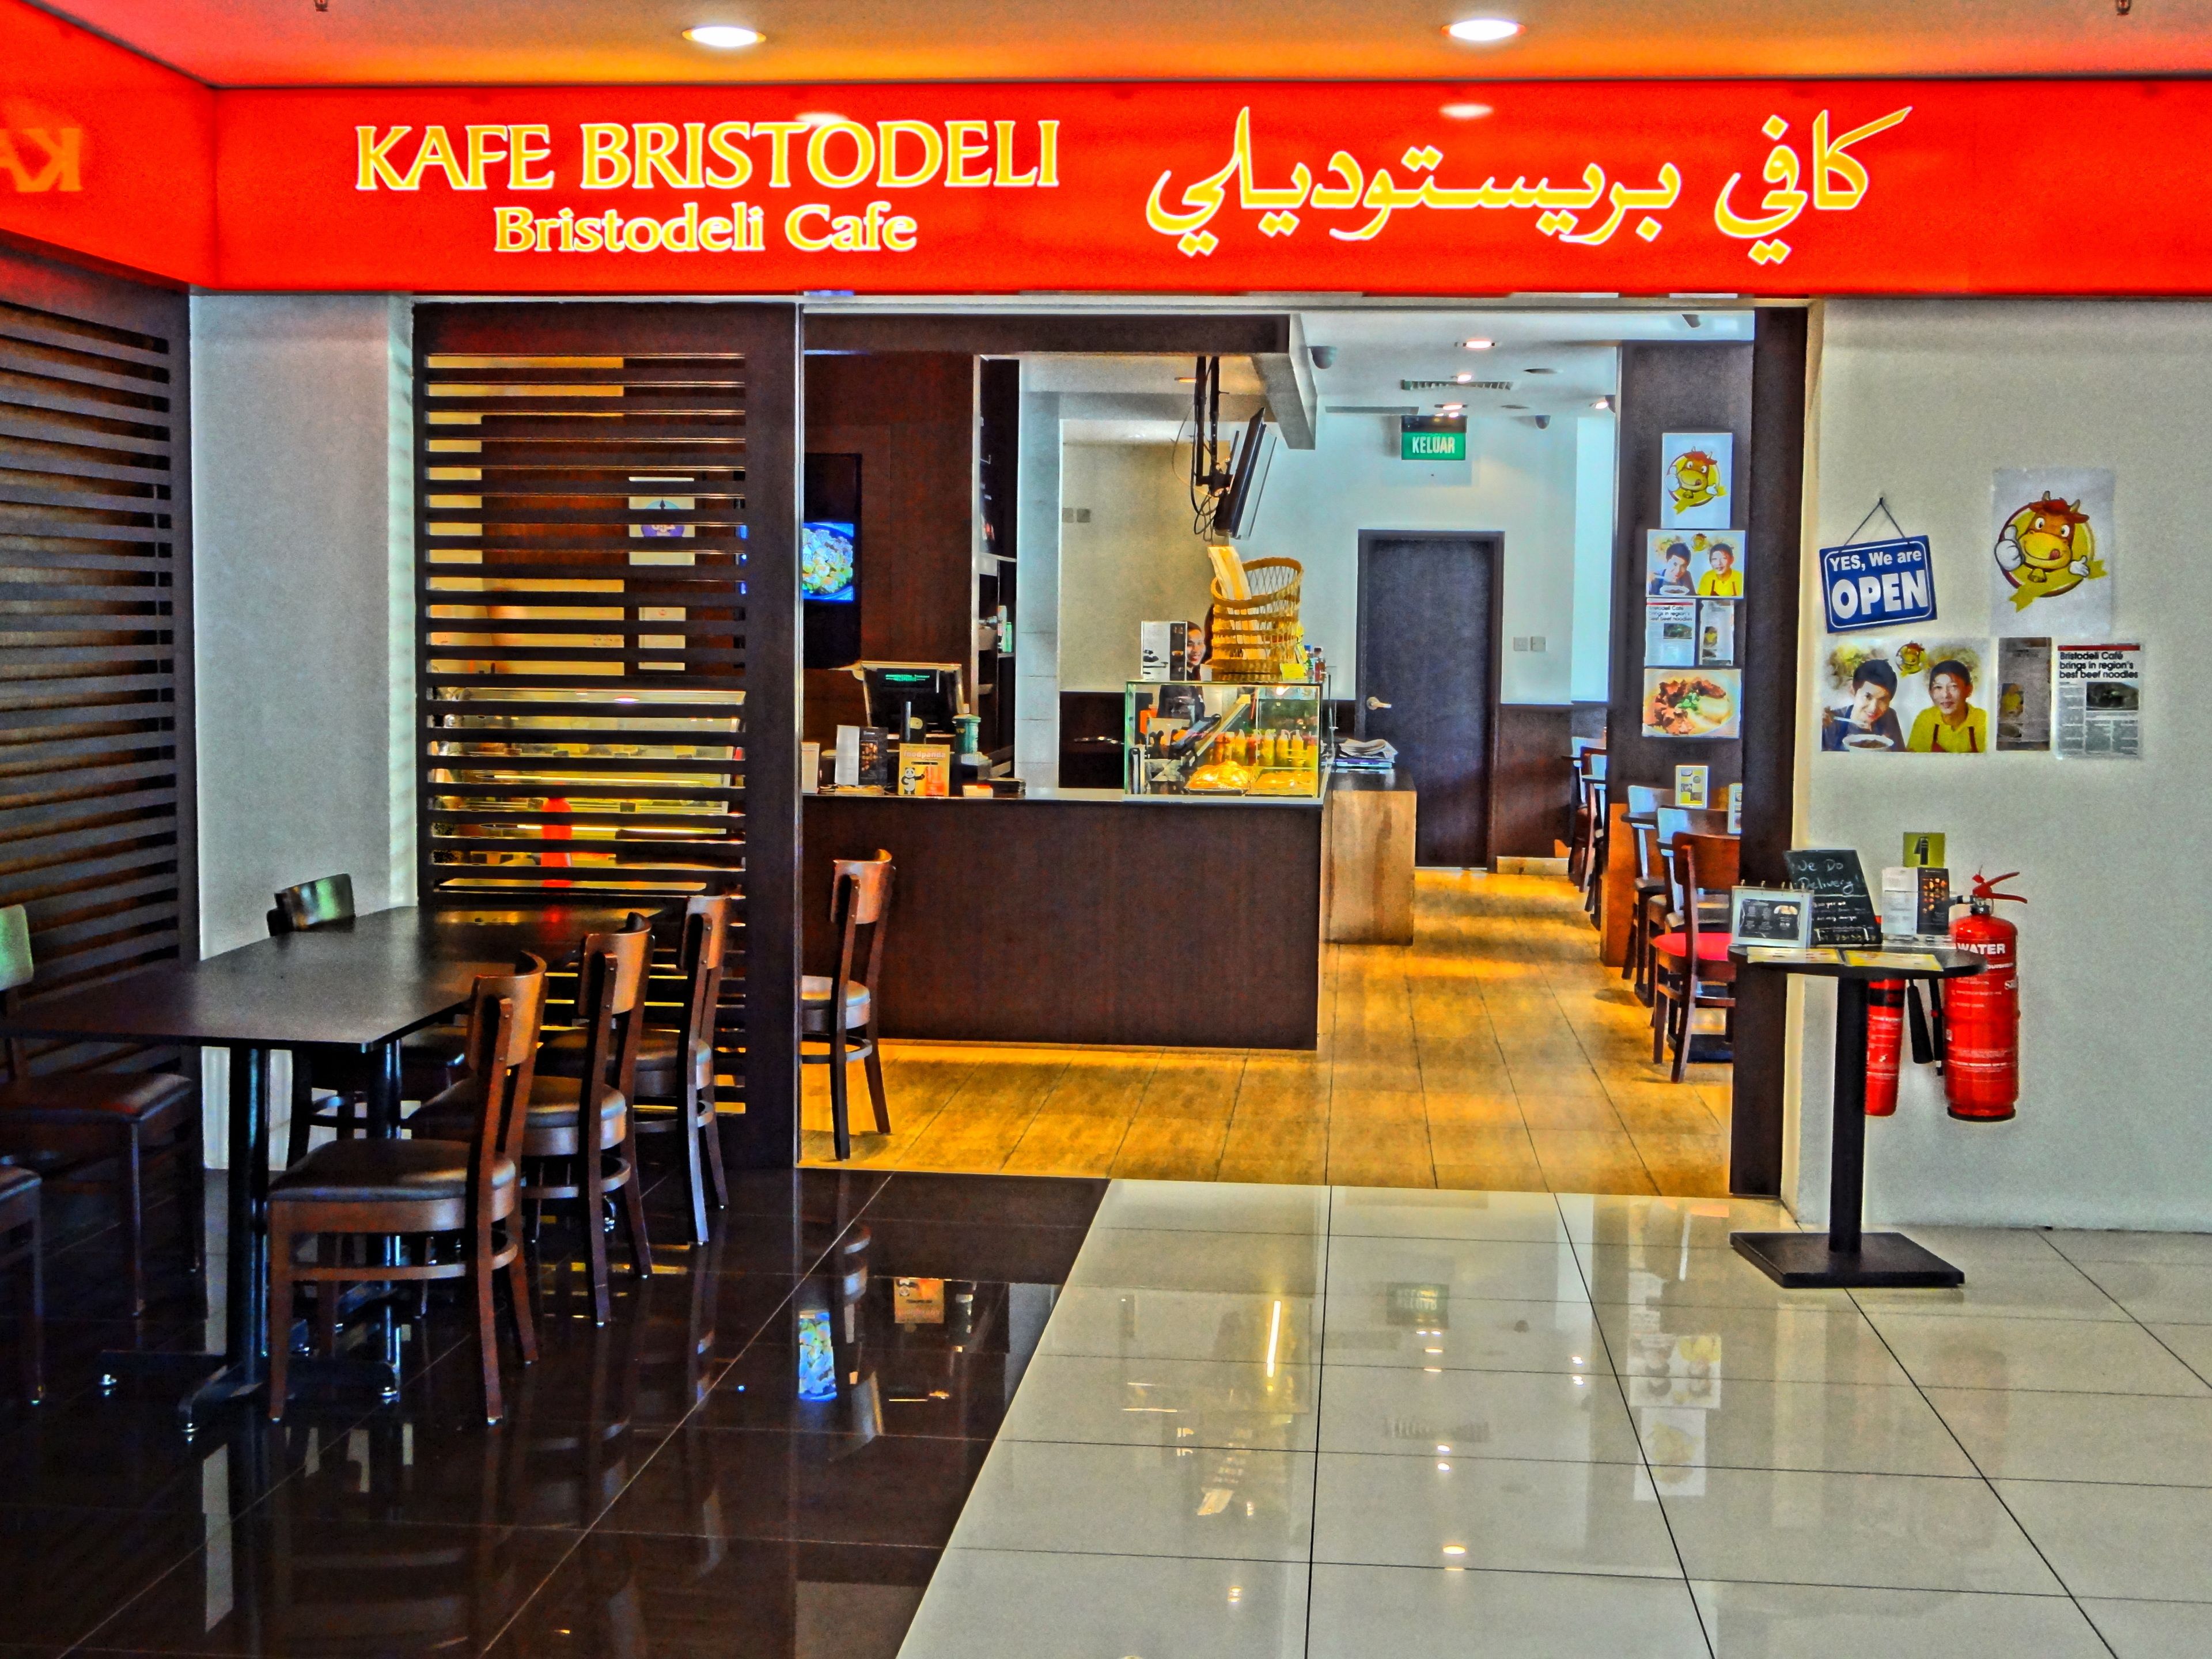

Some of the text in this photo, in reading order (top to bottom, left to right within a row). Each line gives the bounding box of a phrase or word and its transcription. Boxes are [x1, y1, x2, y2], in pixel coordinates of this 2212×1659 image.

[355, 120, 1060, 191] KAFE BRISTODELI
[1145, 105, 1912, 266] كافي بريستوديلي
[493, 200, 918, 252] Bristodeli Cafe
[1412, 436, 1455, 454] KELUAR
[1829, 550, 1922, 571] YES, We are
[1832, 569, 1928, 619] OPEN
[2059, 661, 2134, 671] brings in region's
[2059, 670, 2138, 678] best beef noodles
[903, 750, 946, 759] foodpanda
[1957, 942, 2006, 955] WATER
